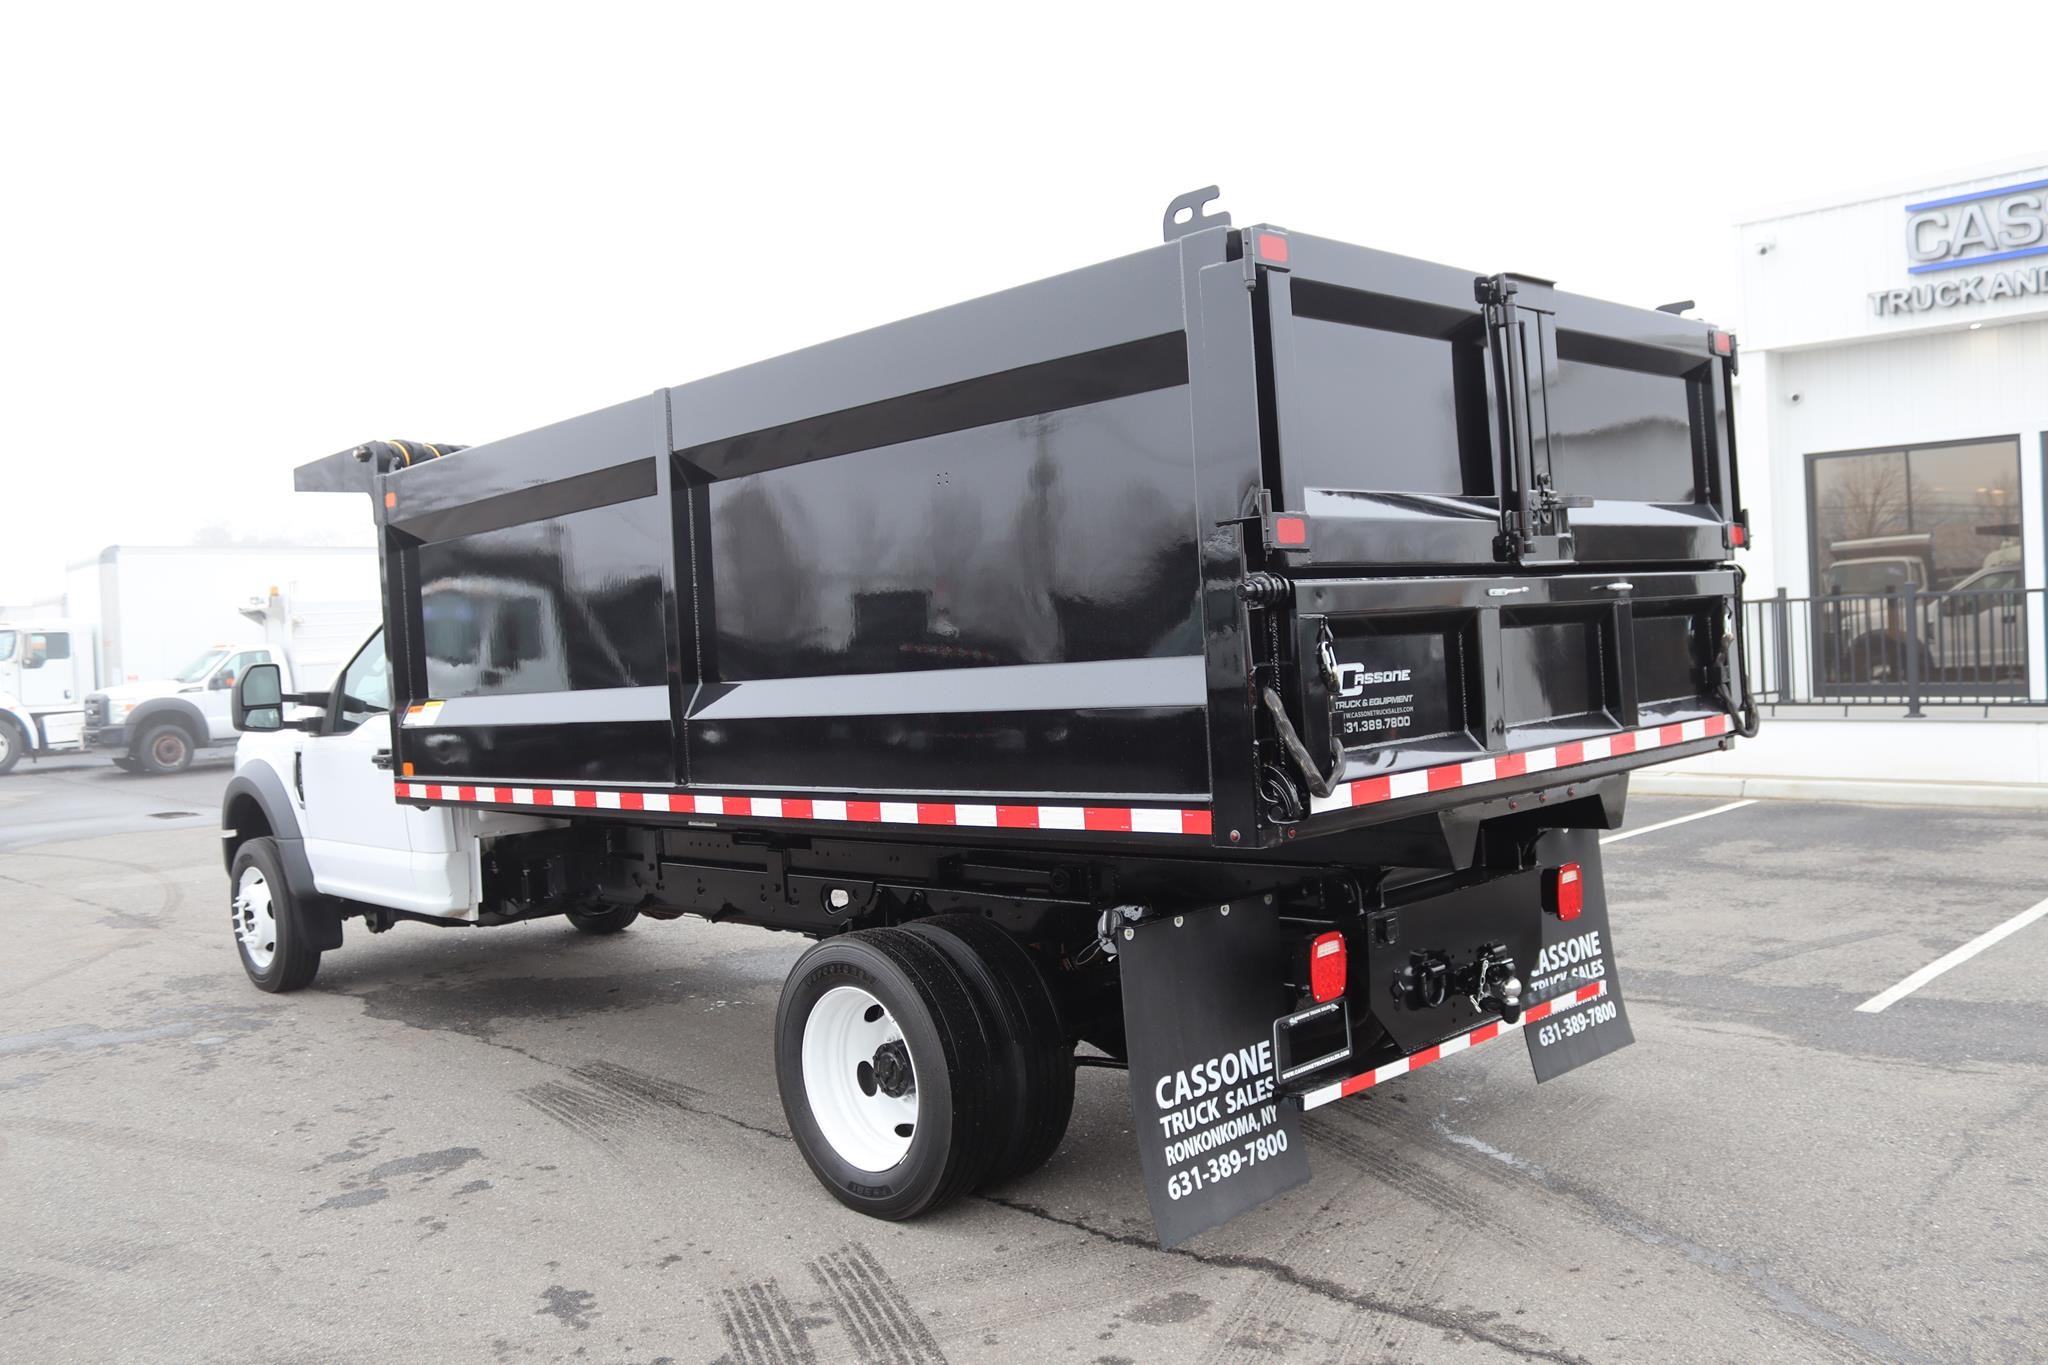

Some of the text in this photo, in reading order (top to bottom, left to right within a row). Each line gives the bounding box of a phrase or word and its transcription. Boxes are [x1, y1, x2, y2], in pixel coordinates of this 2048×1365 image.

[1906, 193, 2048, 262] CAS
[1868, 276, 1985, 316] TRUCK
[1335, 695, 1414, 710] TRUCK & EQUIPMENT
[1343, 706, 1414, 719] W.CASSONETRUCKSALES.COM
[1530, 931, 1602, 977] ASSONE
[1539, 1001, 1617, 1046] 631-389-7800
[1155, 1039, 1273, 1110] CASSONE
[1159, 1075, 1275, 1138] TRUCK SALES
[1164, 1104, 1277, 1167] RONKONKOMA, NY
[1167, 1129, 1288, 1200] 631-389-7800
